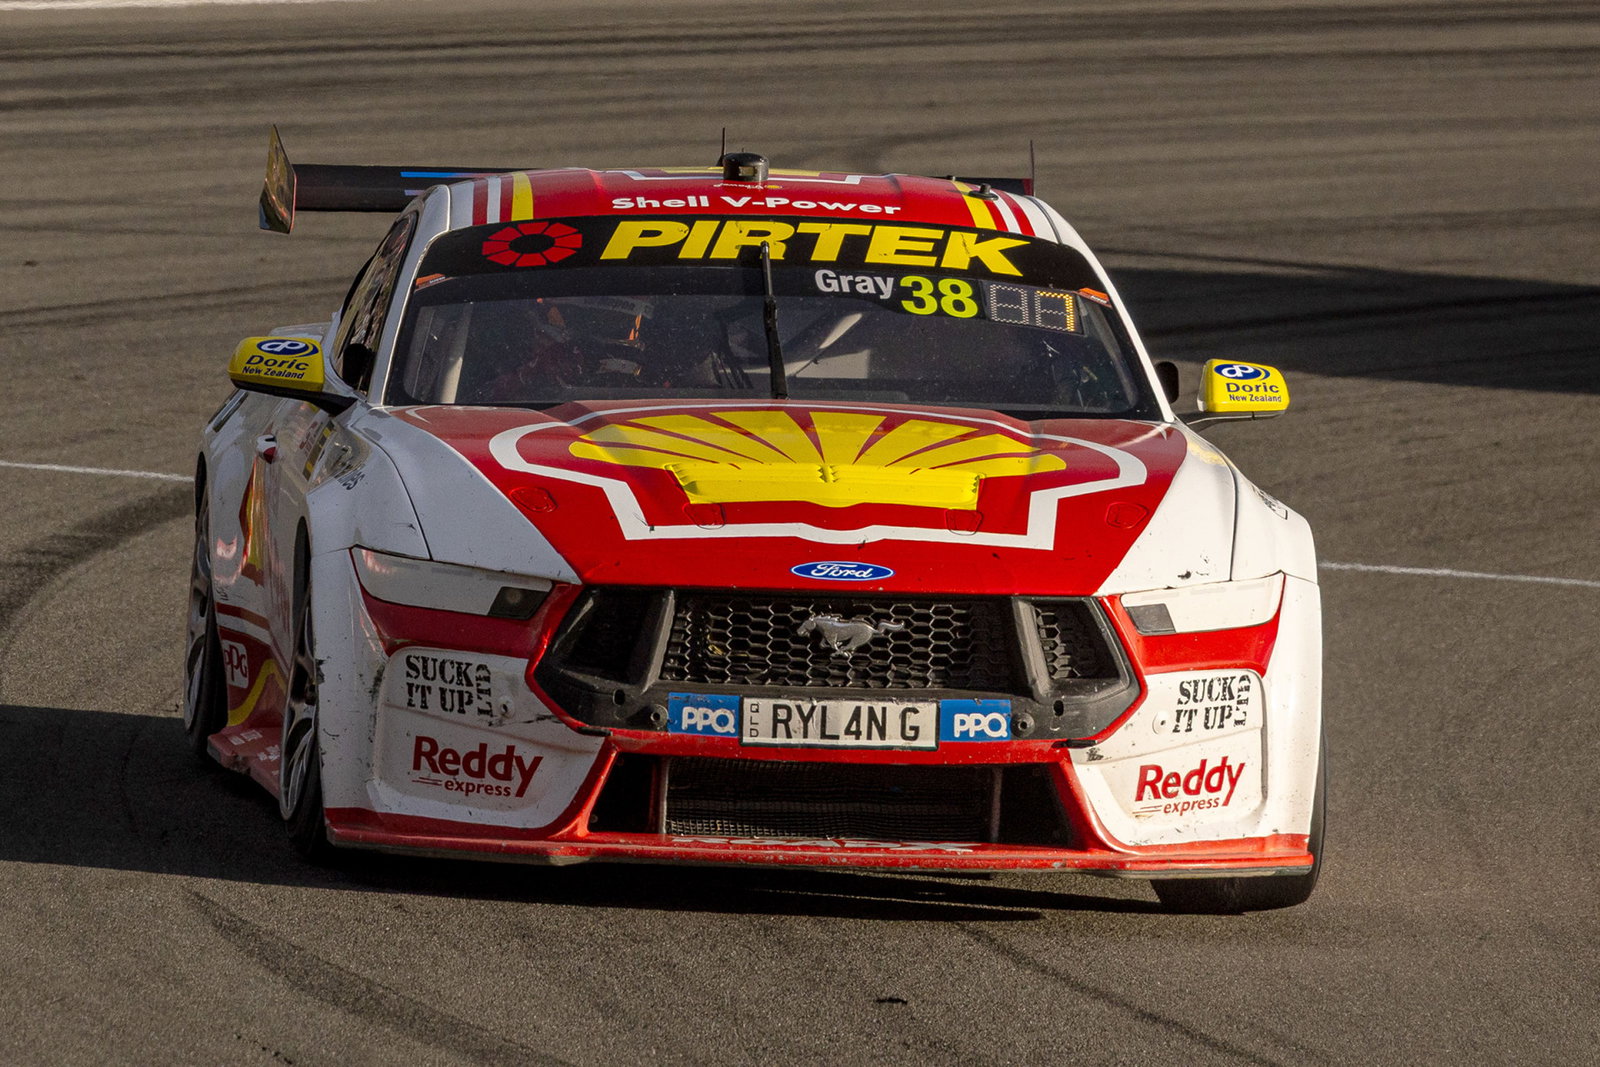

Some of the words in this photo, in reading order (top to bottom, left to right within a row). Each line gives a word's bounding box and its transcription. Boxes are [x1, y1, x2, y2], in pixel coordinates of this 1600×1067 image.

[612, 195, 710, 209] Shell
[719, 195, 902, 215] V-Power
[600, 219, 1031, 277] PIRTEK
[814, 269, 895, 300] Gray
[900, 275, 979, 319] 38
[241, 366, 263, 375] New
[264, 367, 305, 379] Zealand
[245, 354, 309, 371] Doric
[1225, 382, 1280, 394] Doric
[1229, 393, 1247, 402] New
[1249, 394, 1282, 402] Zealand
[811, 563, 874, 578] Ford
[405, 654, 475, 688] SUCK
[406, 682, 432, 710] IT
[439, 687, 474, 715] UP
[1176, 675, 1237, 706] SUCK
[681, 706, 737, 734] PPQ
[771, 703, 888, 741] RYL4N
[900, 706, 921, 742] G
[954, 712, 1008, 738] PPQ
[1171, 708, 1198, 733] IT
[1203, 704, 1233, 730] UP
[412, 735, 544, 798] Reddy
[444, 779, 512, 797] express
[1135, 756, 1246, 806] Reddy
[1163, 796, 1220, 816] express
